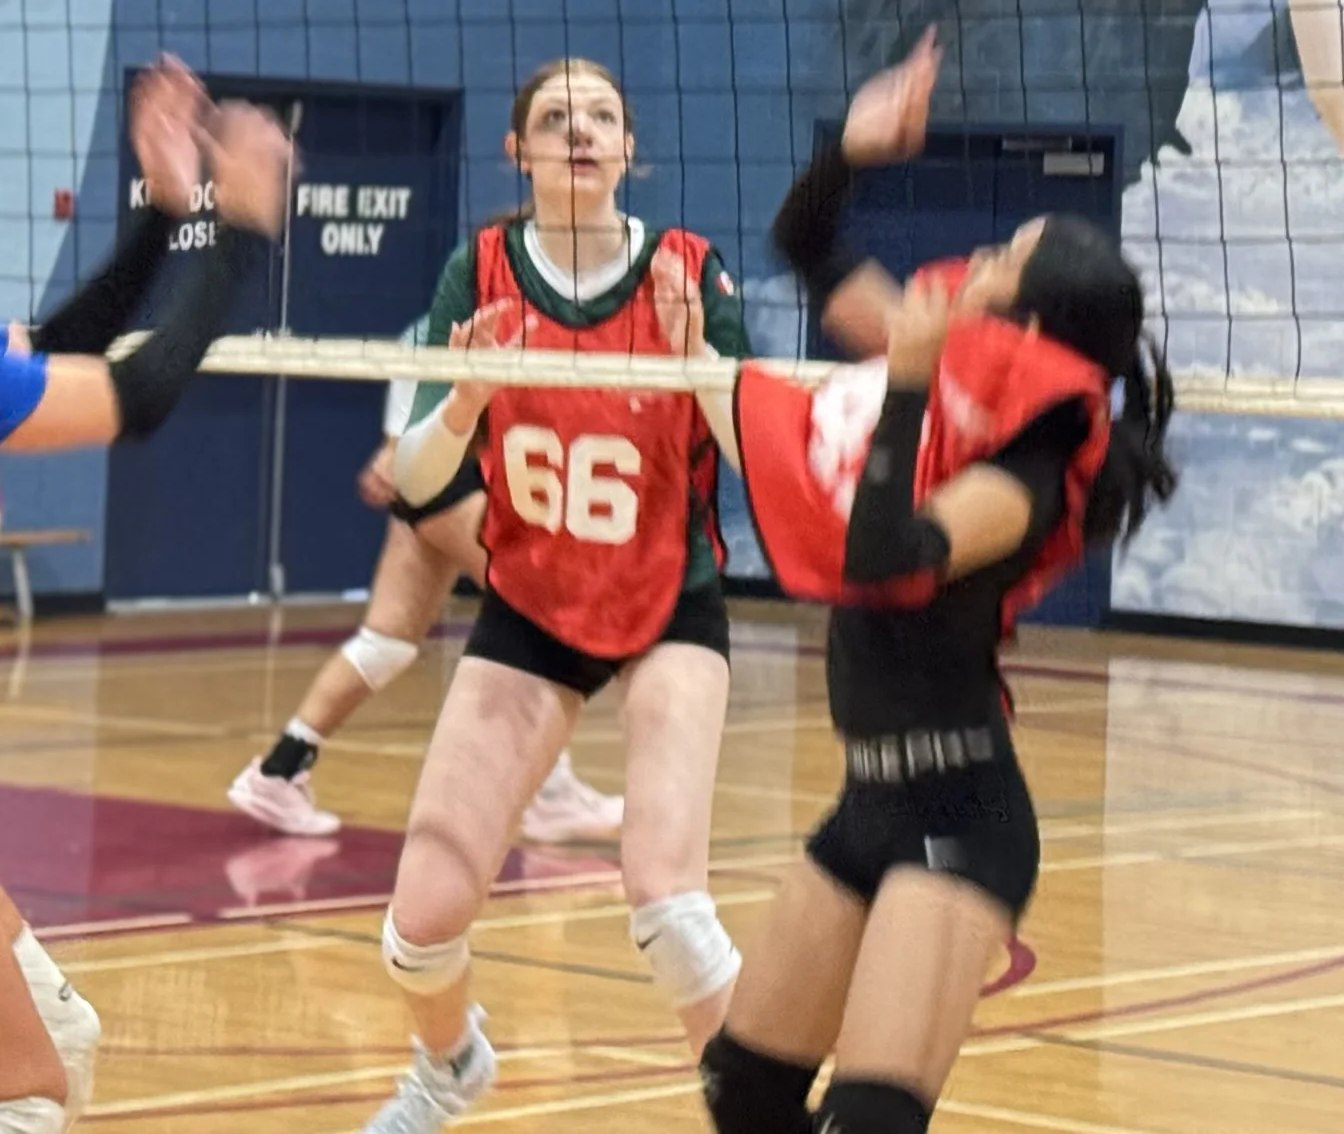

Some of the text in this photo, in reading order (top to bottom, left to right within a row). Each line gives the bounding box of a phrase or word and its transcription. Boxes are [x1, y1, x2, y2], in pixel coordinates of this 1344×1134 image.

[297, 183, 411, 220] FIRE EXIT
[321, 222, 384, 257] ONLY
[503, 424, 641, 546] 66
